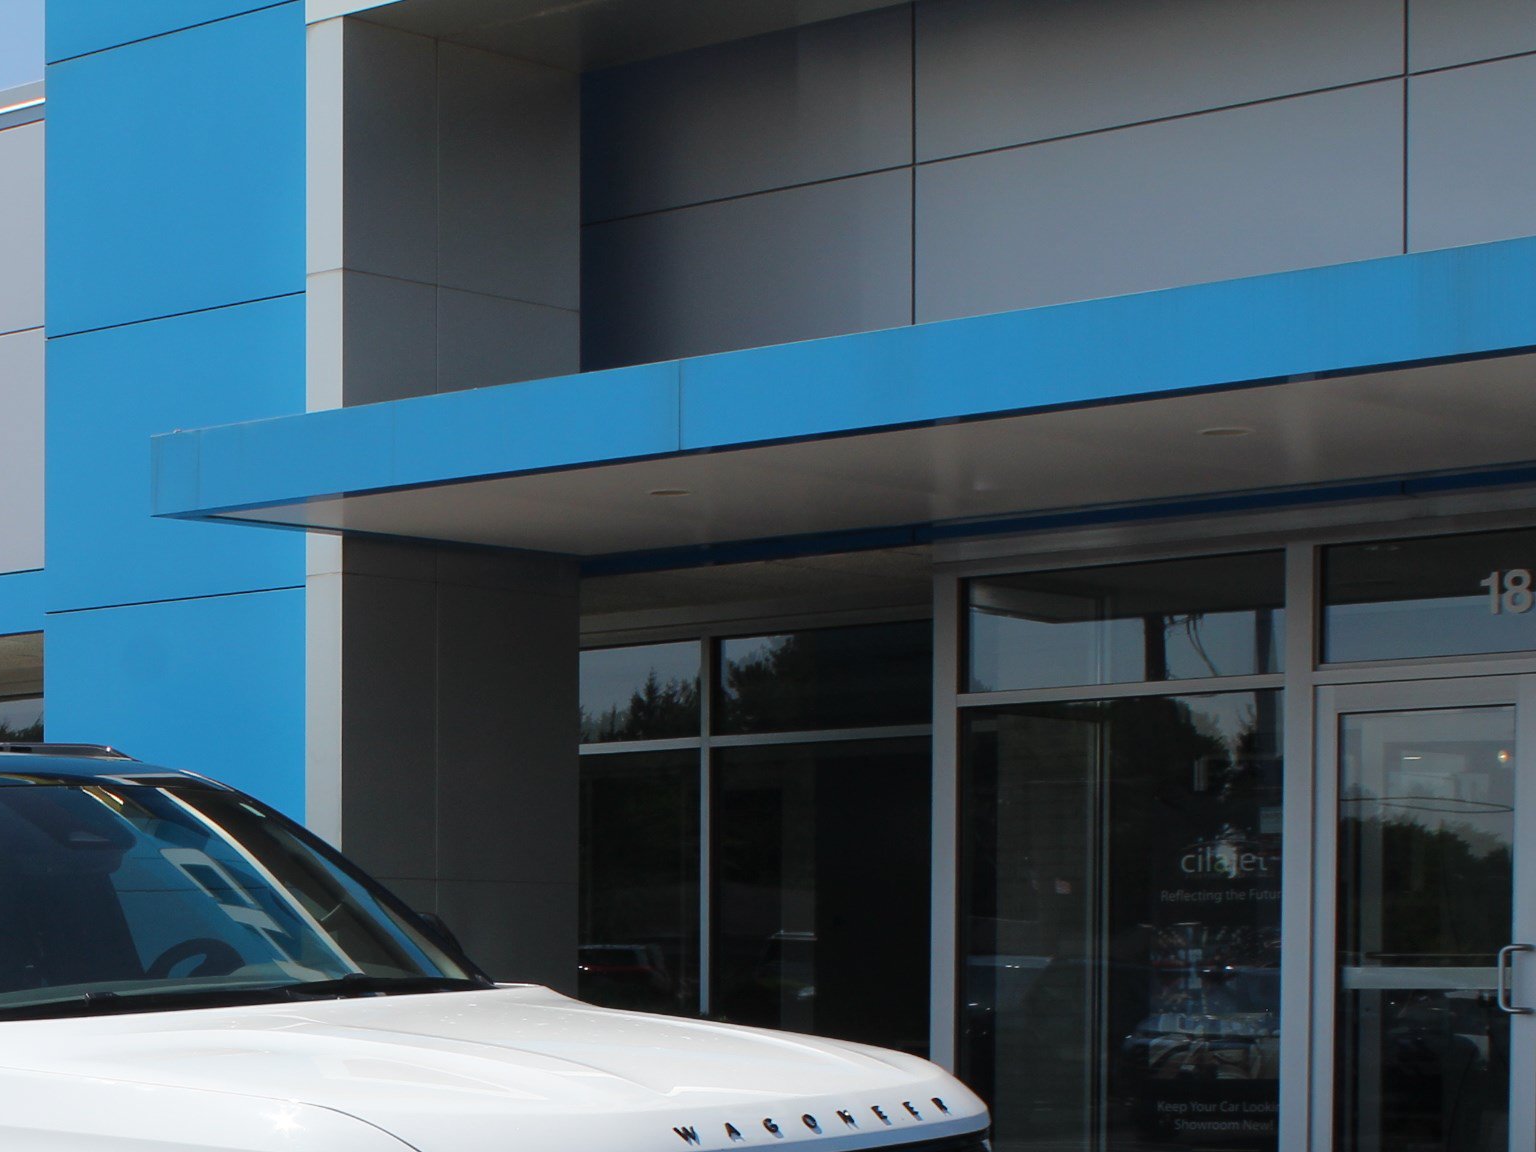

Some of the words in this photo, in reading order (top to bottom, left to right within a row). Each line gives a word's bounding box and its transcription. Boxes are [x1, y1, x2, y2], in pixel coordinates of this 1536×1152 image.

[1161, 889, 1222, 904] Reflecting
[1225, 889, 1246, 901] the
[1157, 1101, 1187, 1114] Keep
[1190, 1101, 1216, 1112] Your
[1219, 1101, 1239, 1112] Car
[672, 1096, 949, 1144] WAGONEER
[1174, 1118, 1239, 1130] Showroom
